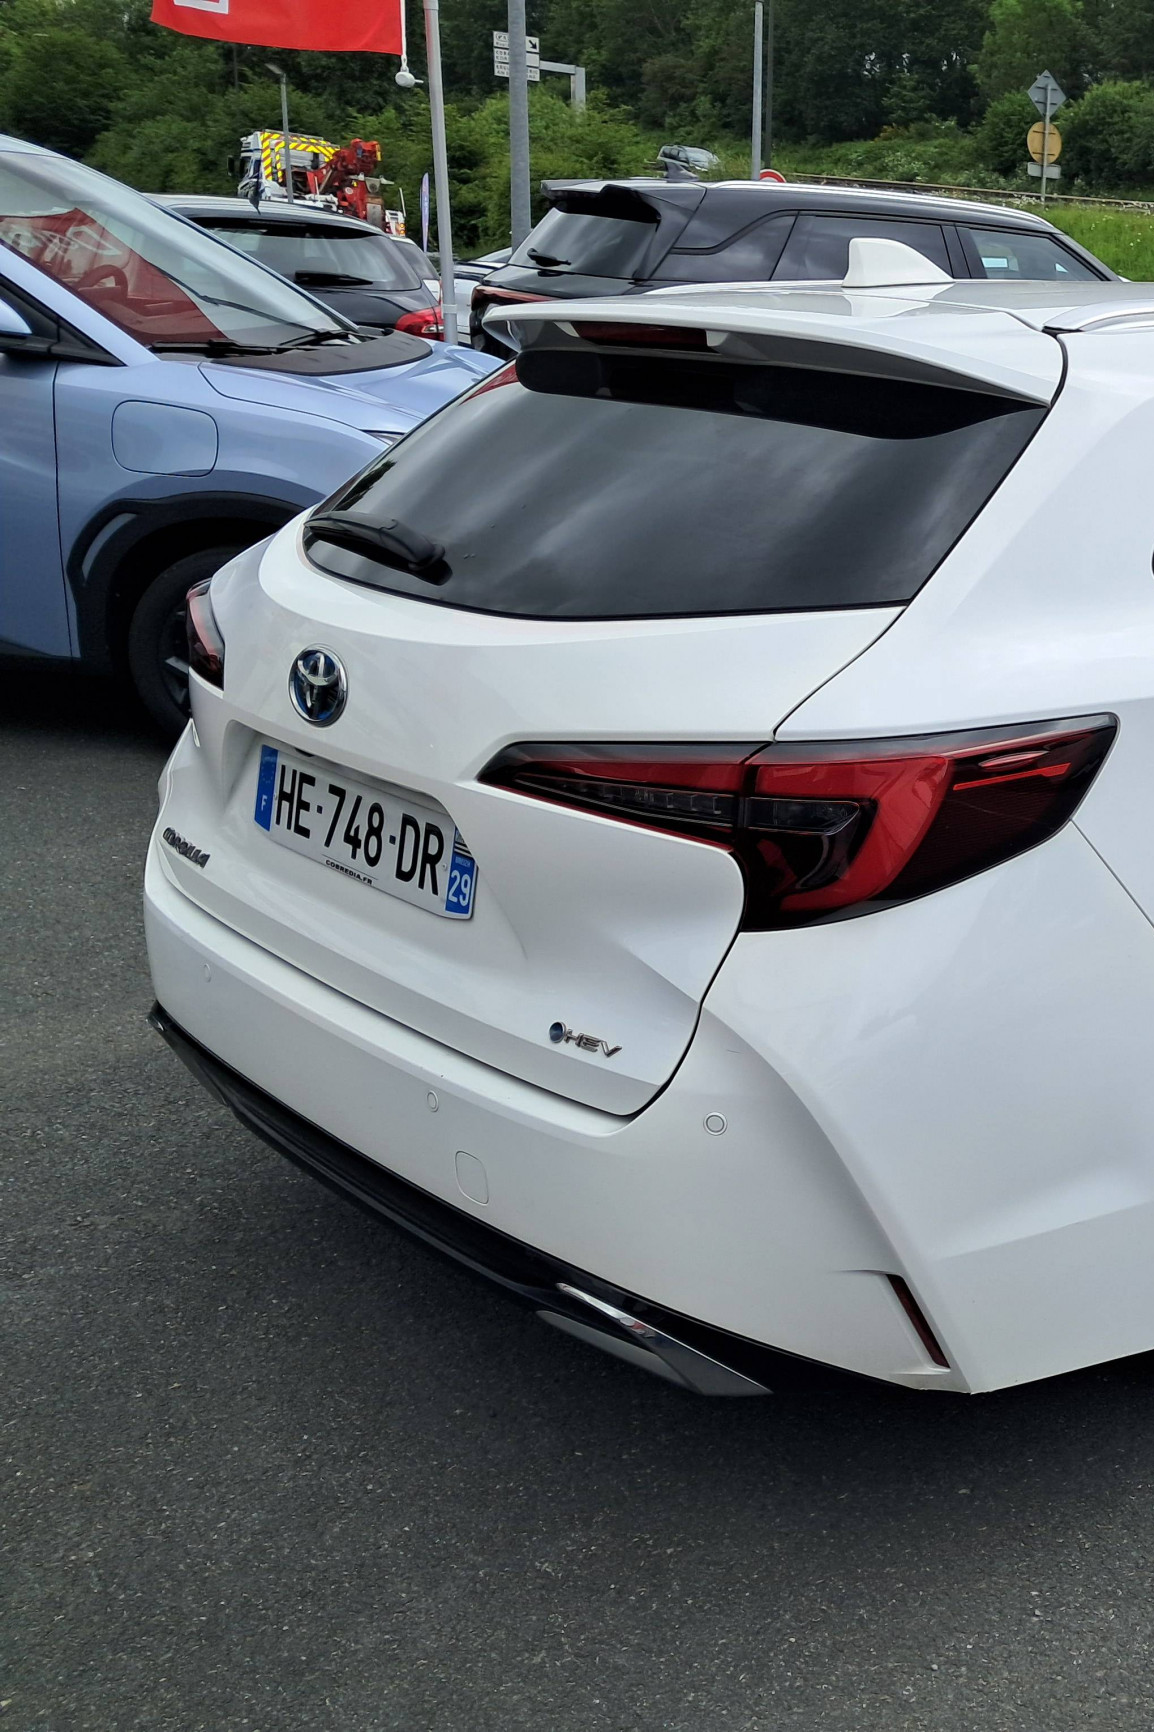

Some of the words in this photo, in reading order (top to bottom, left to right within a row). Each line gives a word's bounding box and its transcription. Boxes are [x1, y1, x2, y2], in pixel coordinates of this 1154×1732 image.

[261, 794, 268, 812] F
[447, 869, 472, 907] 29
[563, 1028, 623, 1058] HEV
